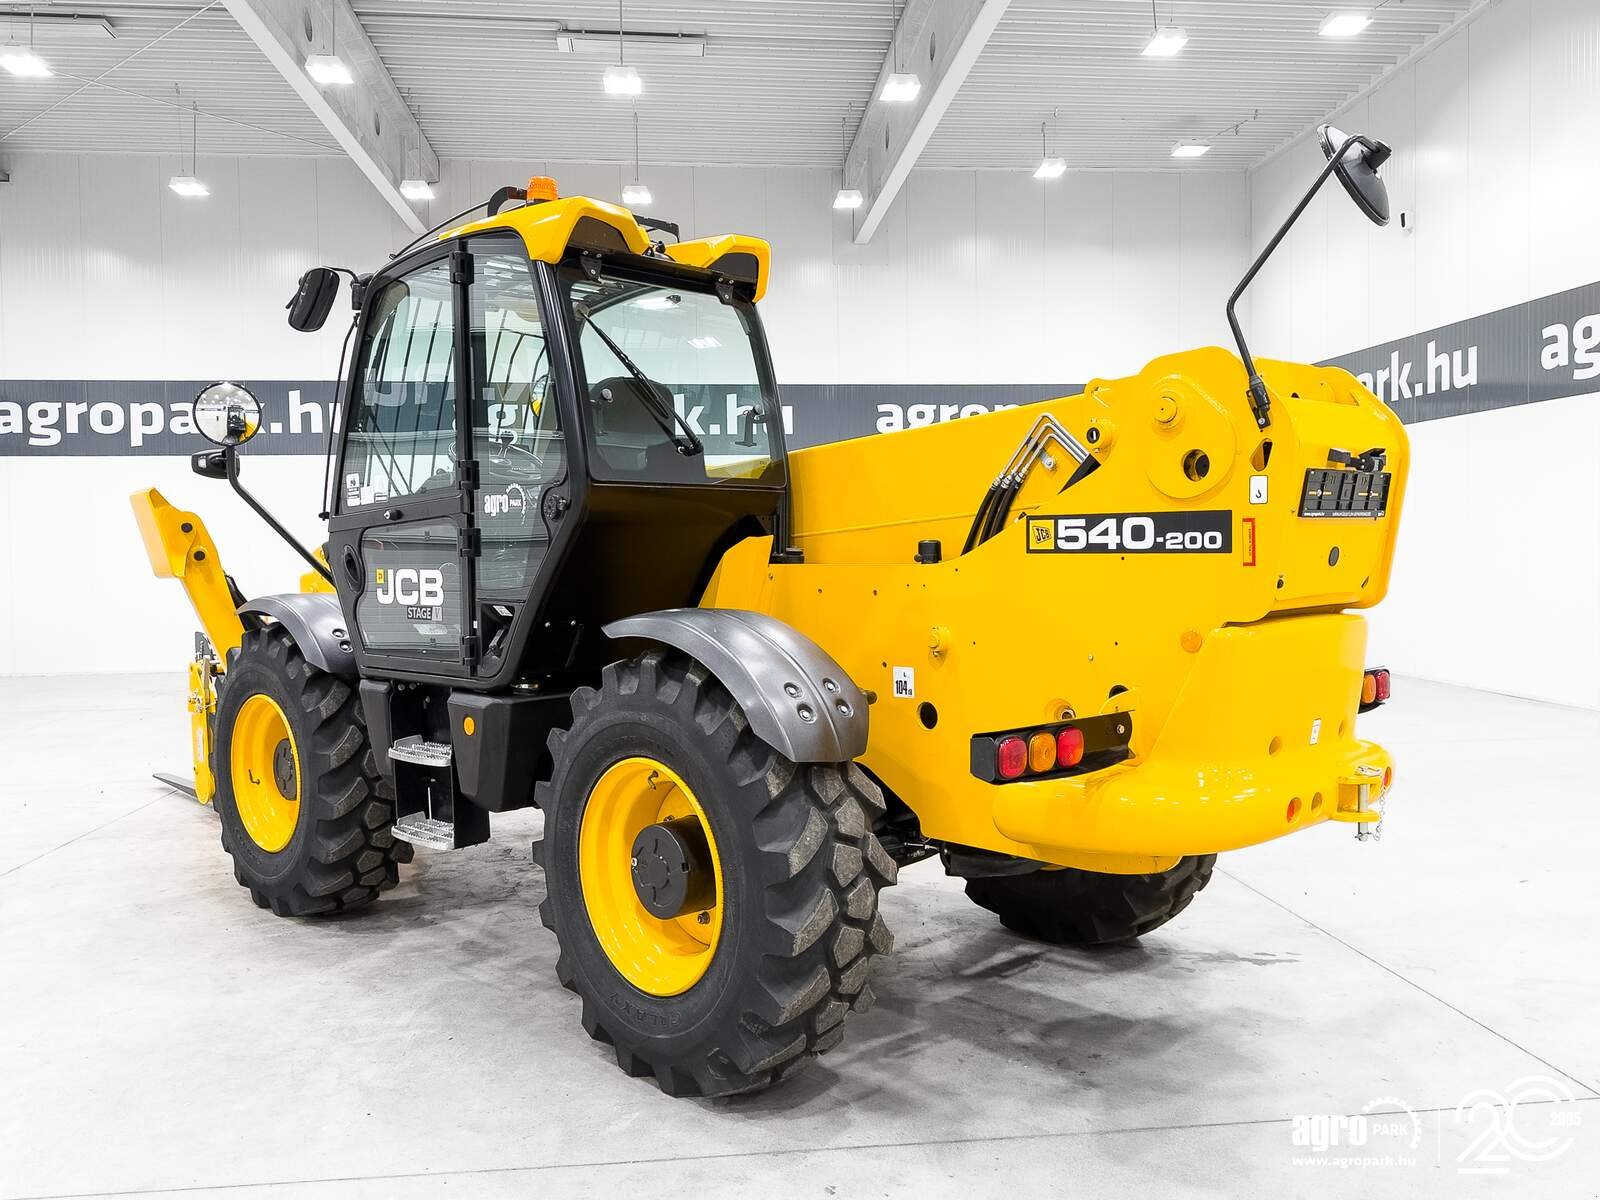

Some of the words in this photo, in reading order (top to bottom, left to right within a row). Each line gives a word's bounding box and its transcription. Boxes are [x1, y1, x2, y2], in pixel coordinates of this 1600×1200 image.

[484, 494, 509, 517] agro
[1035, 526, 1051, 543] JCB
[1056, 516, 1223, 550] 540-200
[376, 568, 445, 607] JCB
[407, 607, 432, 620] STAGE
[895, 679, 908, 696] 104
